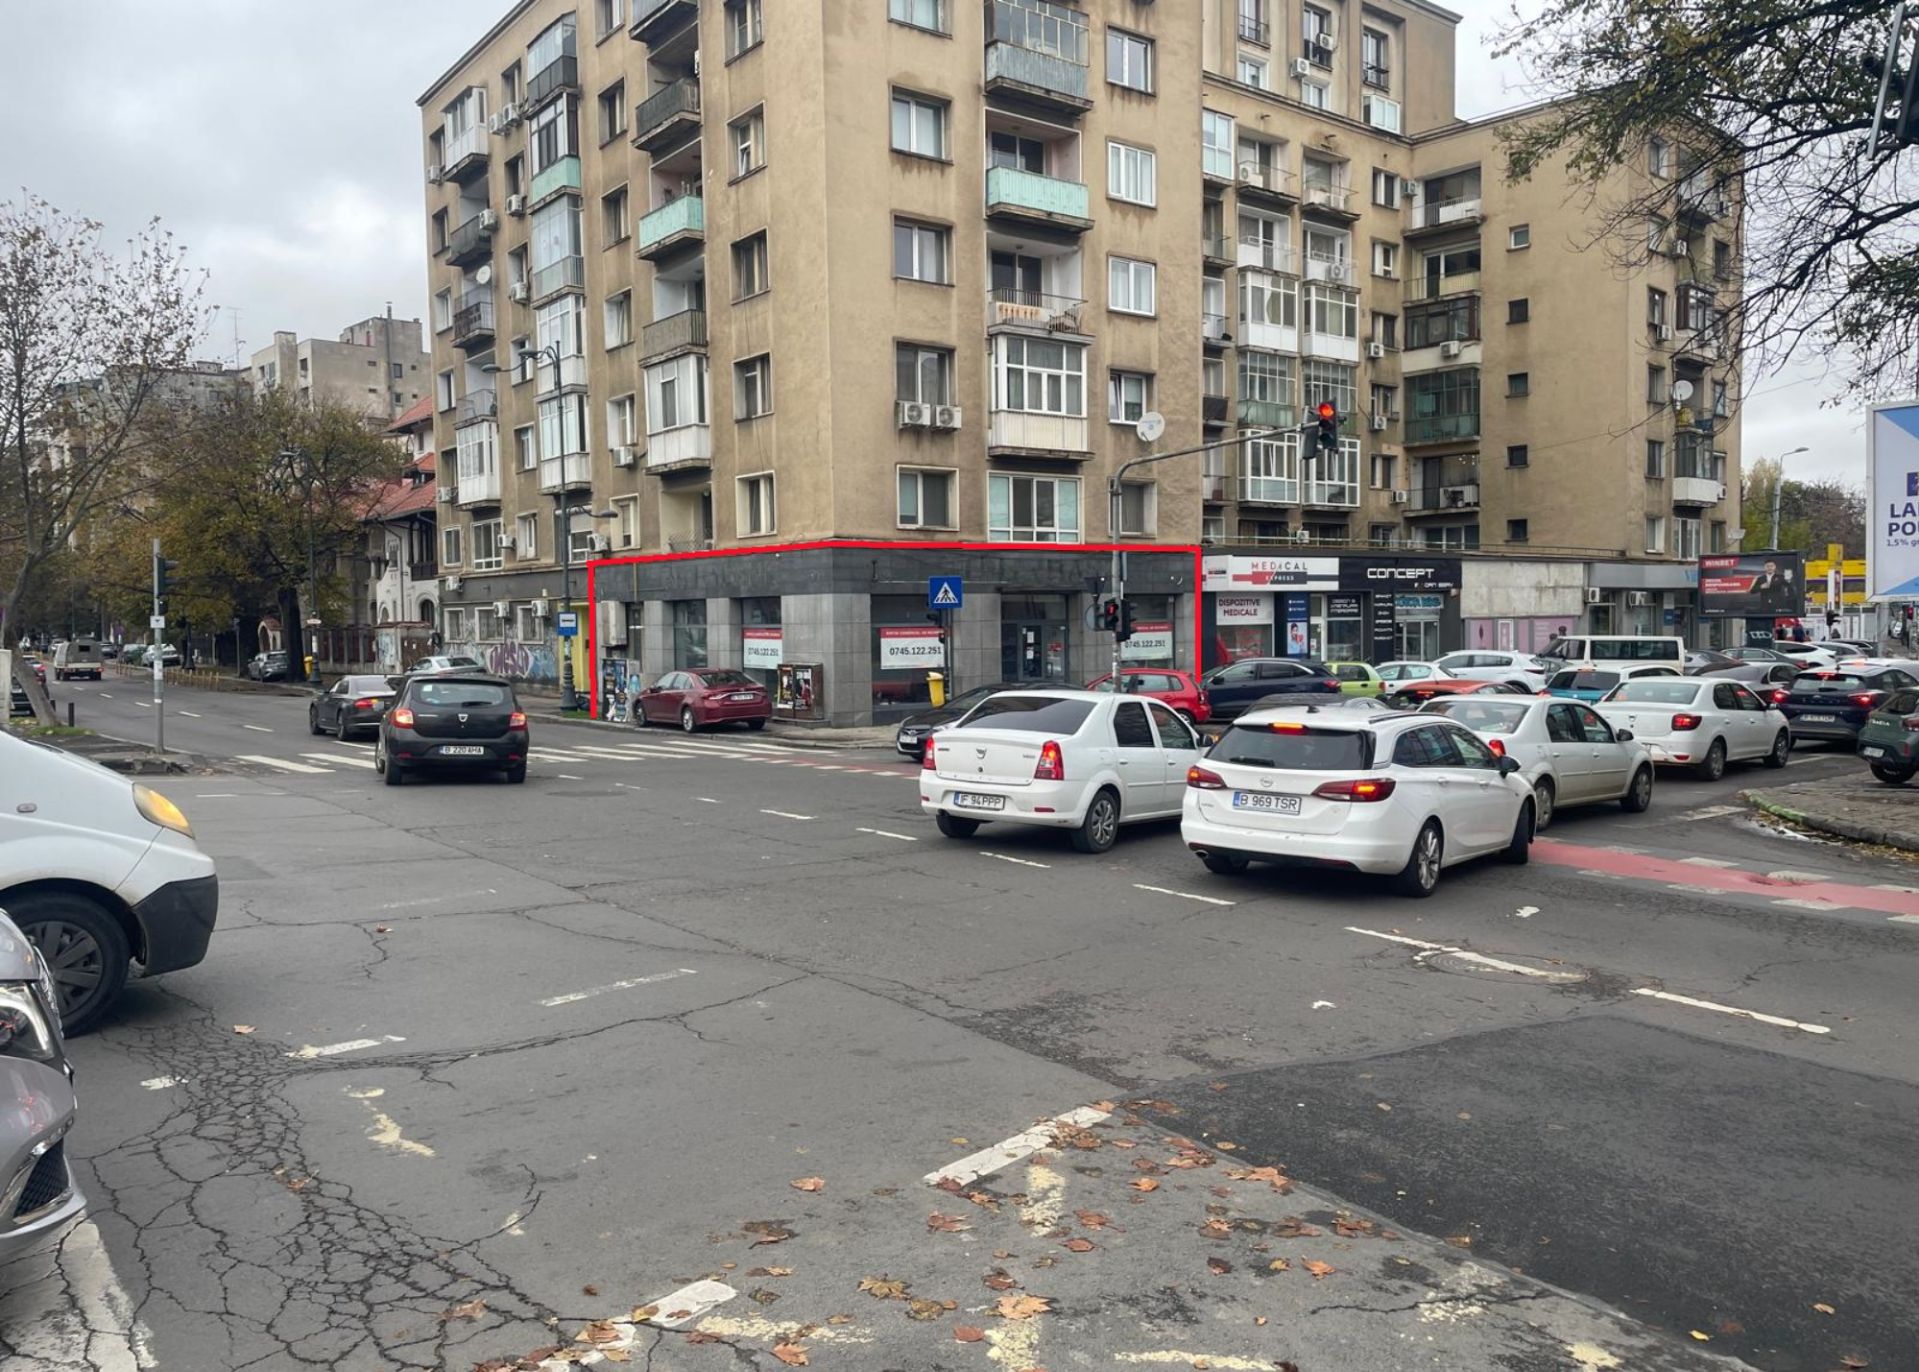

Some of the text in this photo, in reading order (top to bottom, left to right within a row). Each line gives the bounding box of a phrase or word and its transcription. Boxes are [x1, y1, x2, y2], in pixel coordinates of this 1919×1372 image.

[1890, 501, 1919, 518] LA
[1888, 521, 1919, 537] PO
[1251, 561, 1308, 571] MEDICAL
[1367, 567, 1435, 579] CONCEPT
[1218, 598, 1261, 607] DISPOZITIVE
[1223, 608, 1258, 617] MEDICALE
[889, 646, 942, 656] 0745.122.251
[982, 796, 1001, 806] PPP
[1240, 794, 1297, 810] B 969 TSR
